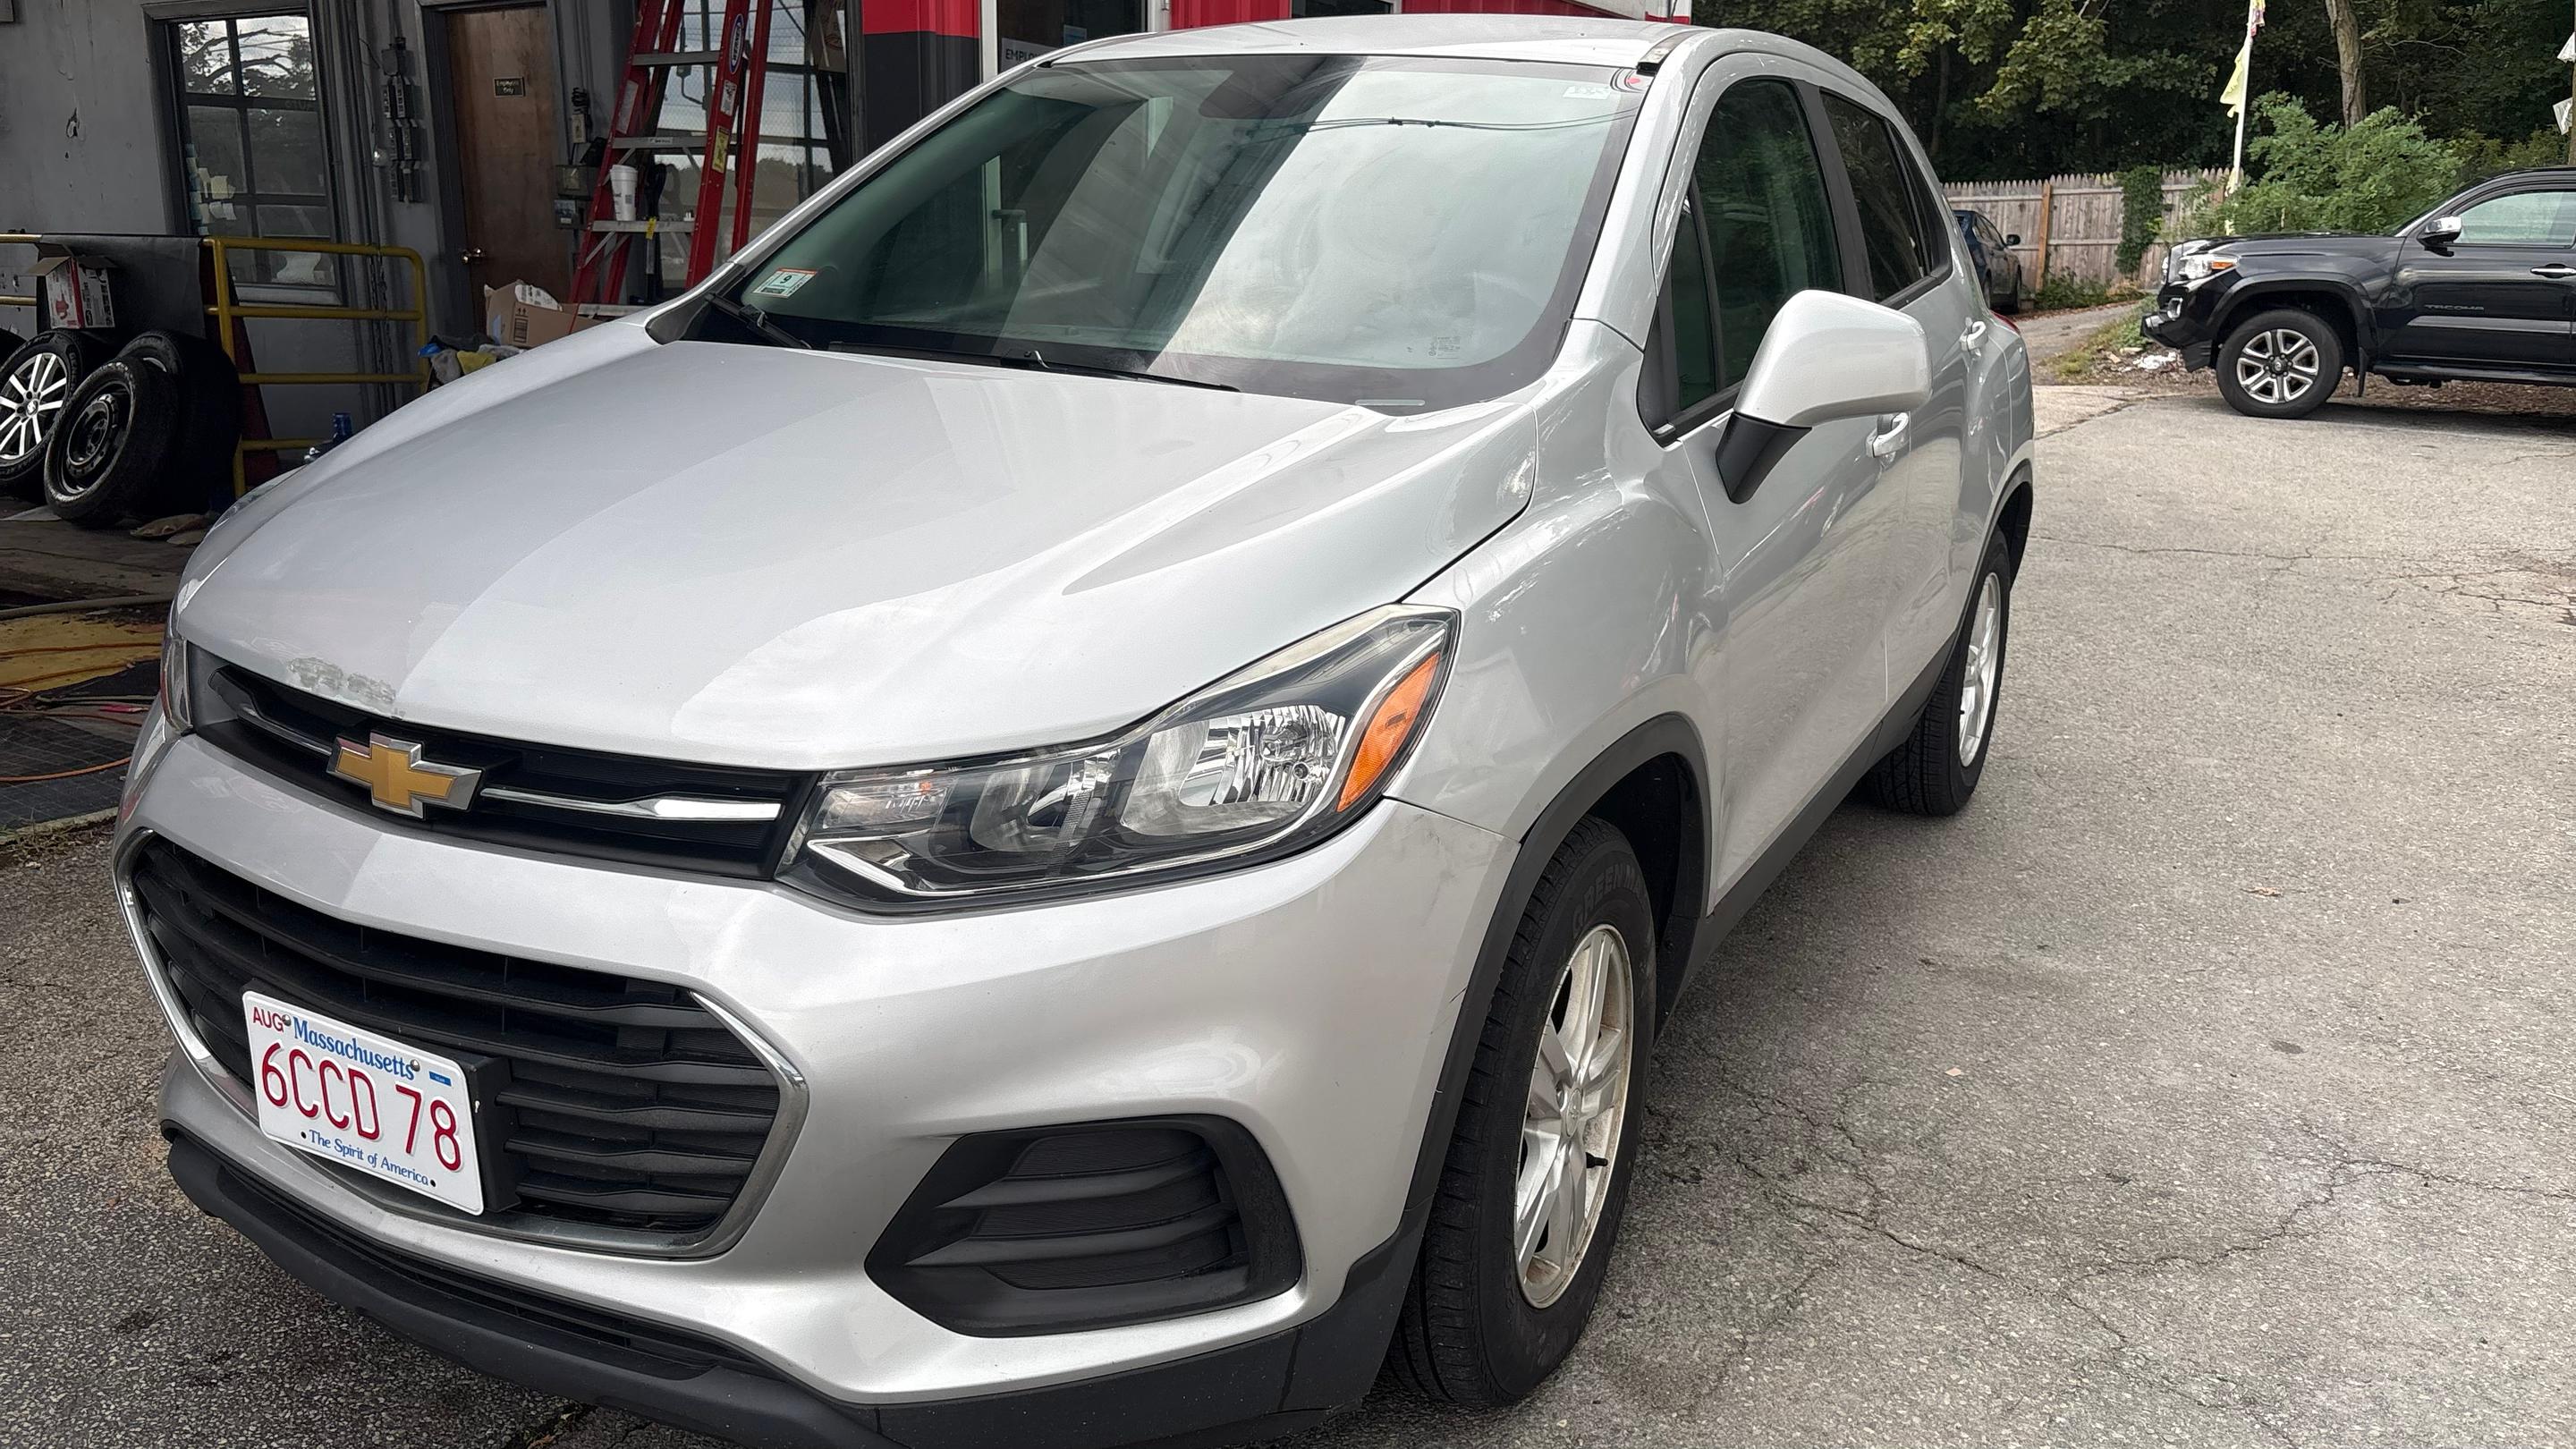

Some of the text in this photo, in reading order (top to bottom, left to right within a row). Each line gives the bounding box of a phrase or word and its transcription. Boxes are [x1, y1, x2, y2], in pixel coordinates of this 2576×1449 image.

[252, 1006, 414, 1080] AUG Massachusetts
[261, 1042, 462, 1172] 6CCD 78
[309, 1129, 429, 1186] The Spirit of America
